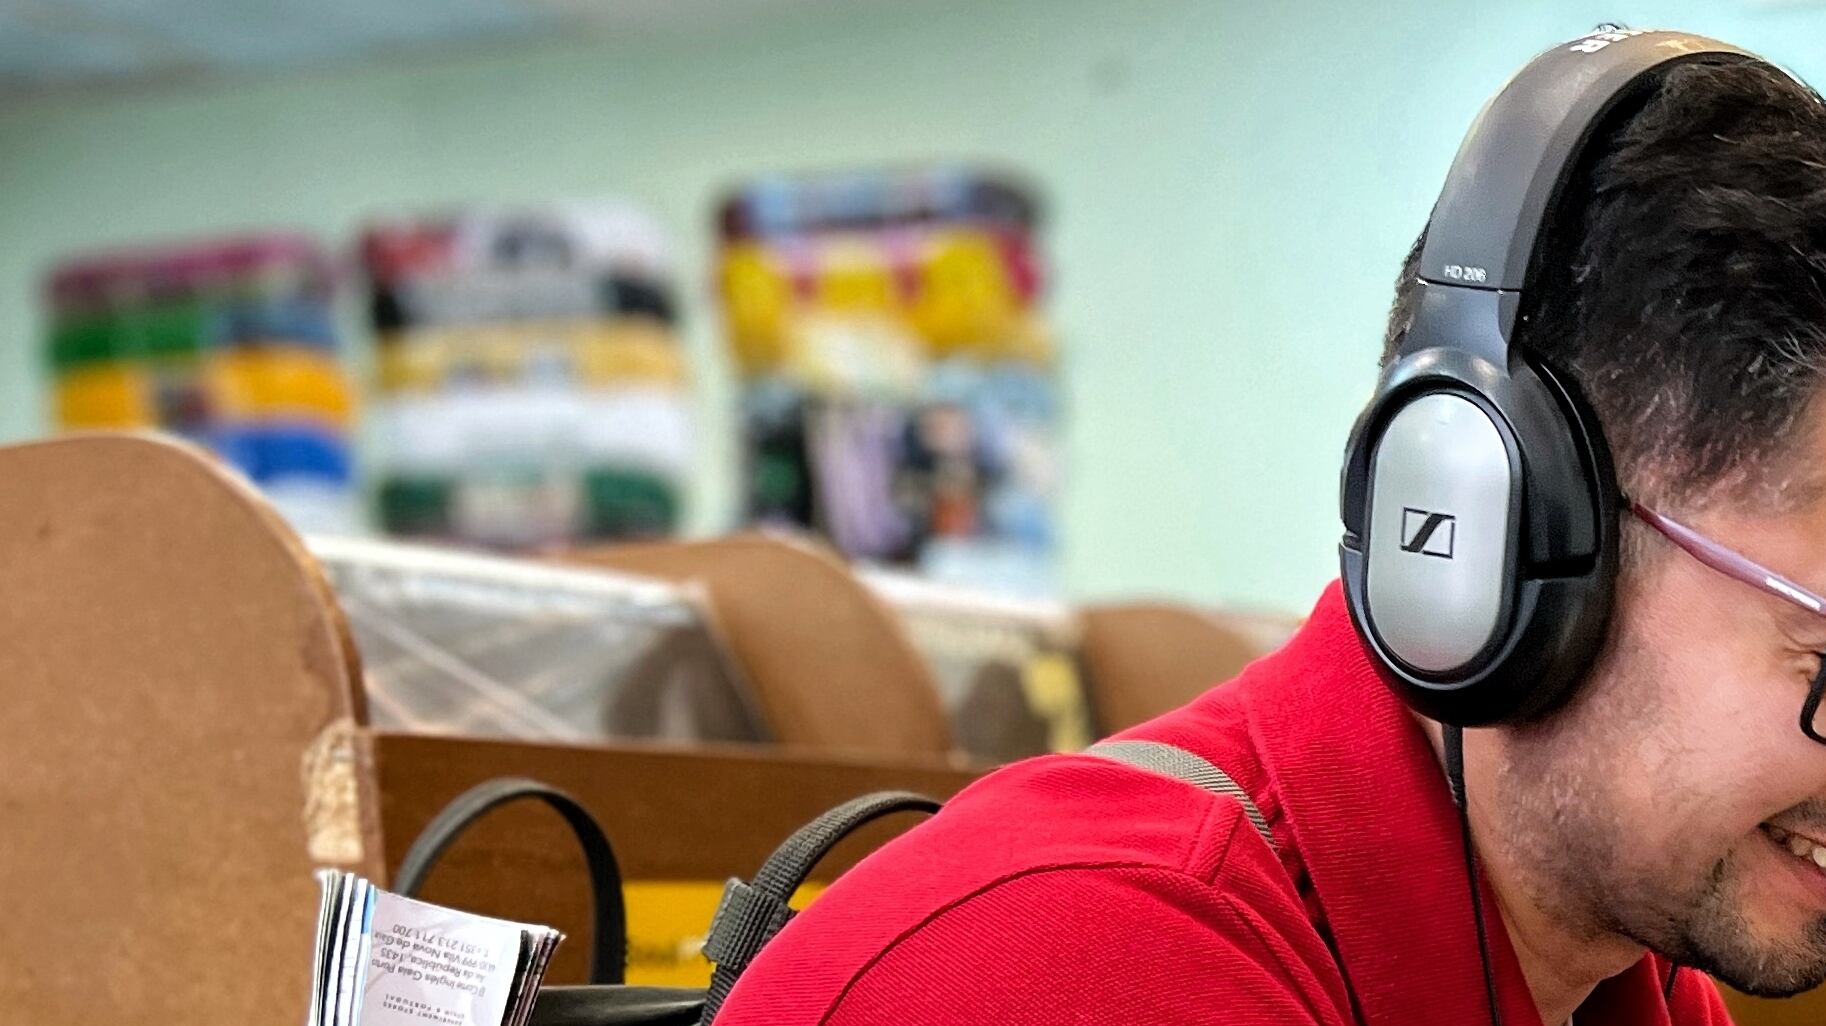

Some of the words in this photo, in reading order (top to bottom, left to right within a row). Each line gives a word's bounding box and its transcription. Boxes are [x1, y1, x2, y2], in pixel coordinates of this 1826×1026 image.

[1444, 265, 1463, 279] HD
[392, 924, 412, 938] 700
[396, 938, 411, 950] de
[413, 943, 441, 959] Nova
[371, 959, 396, 973] Porto
[398, 966, 423, 981] Gaia
